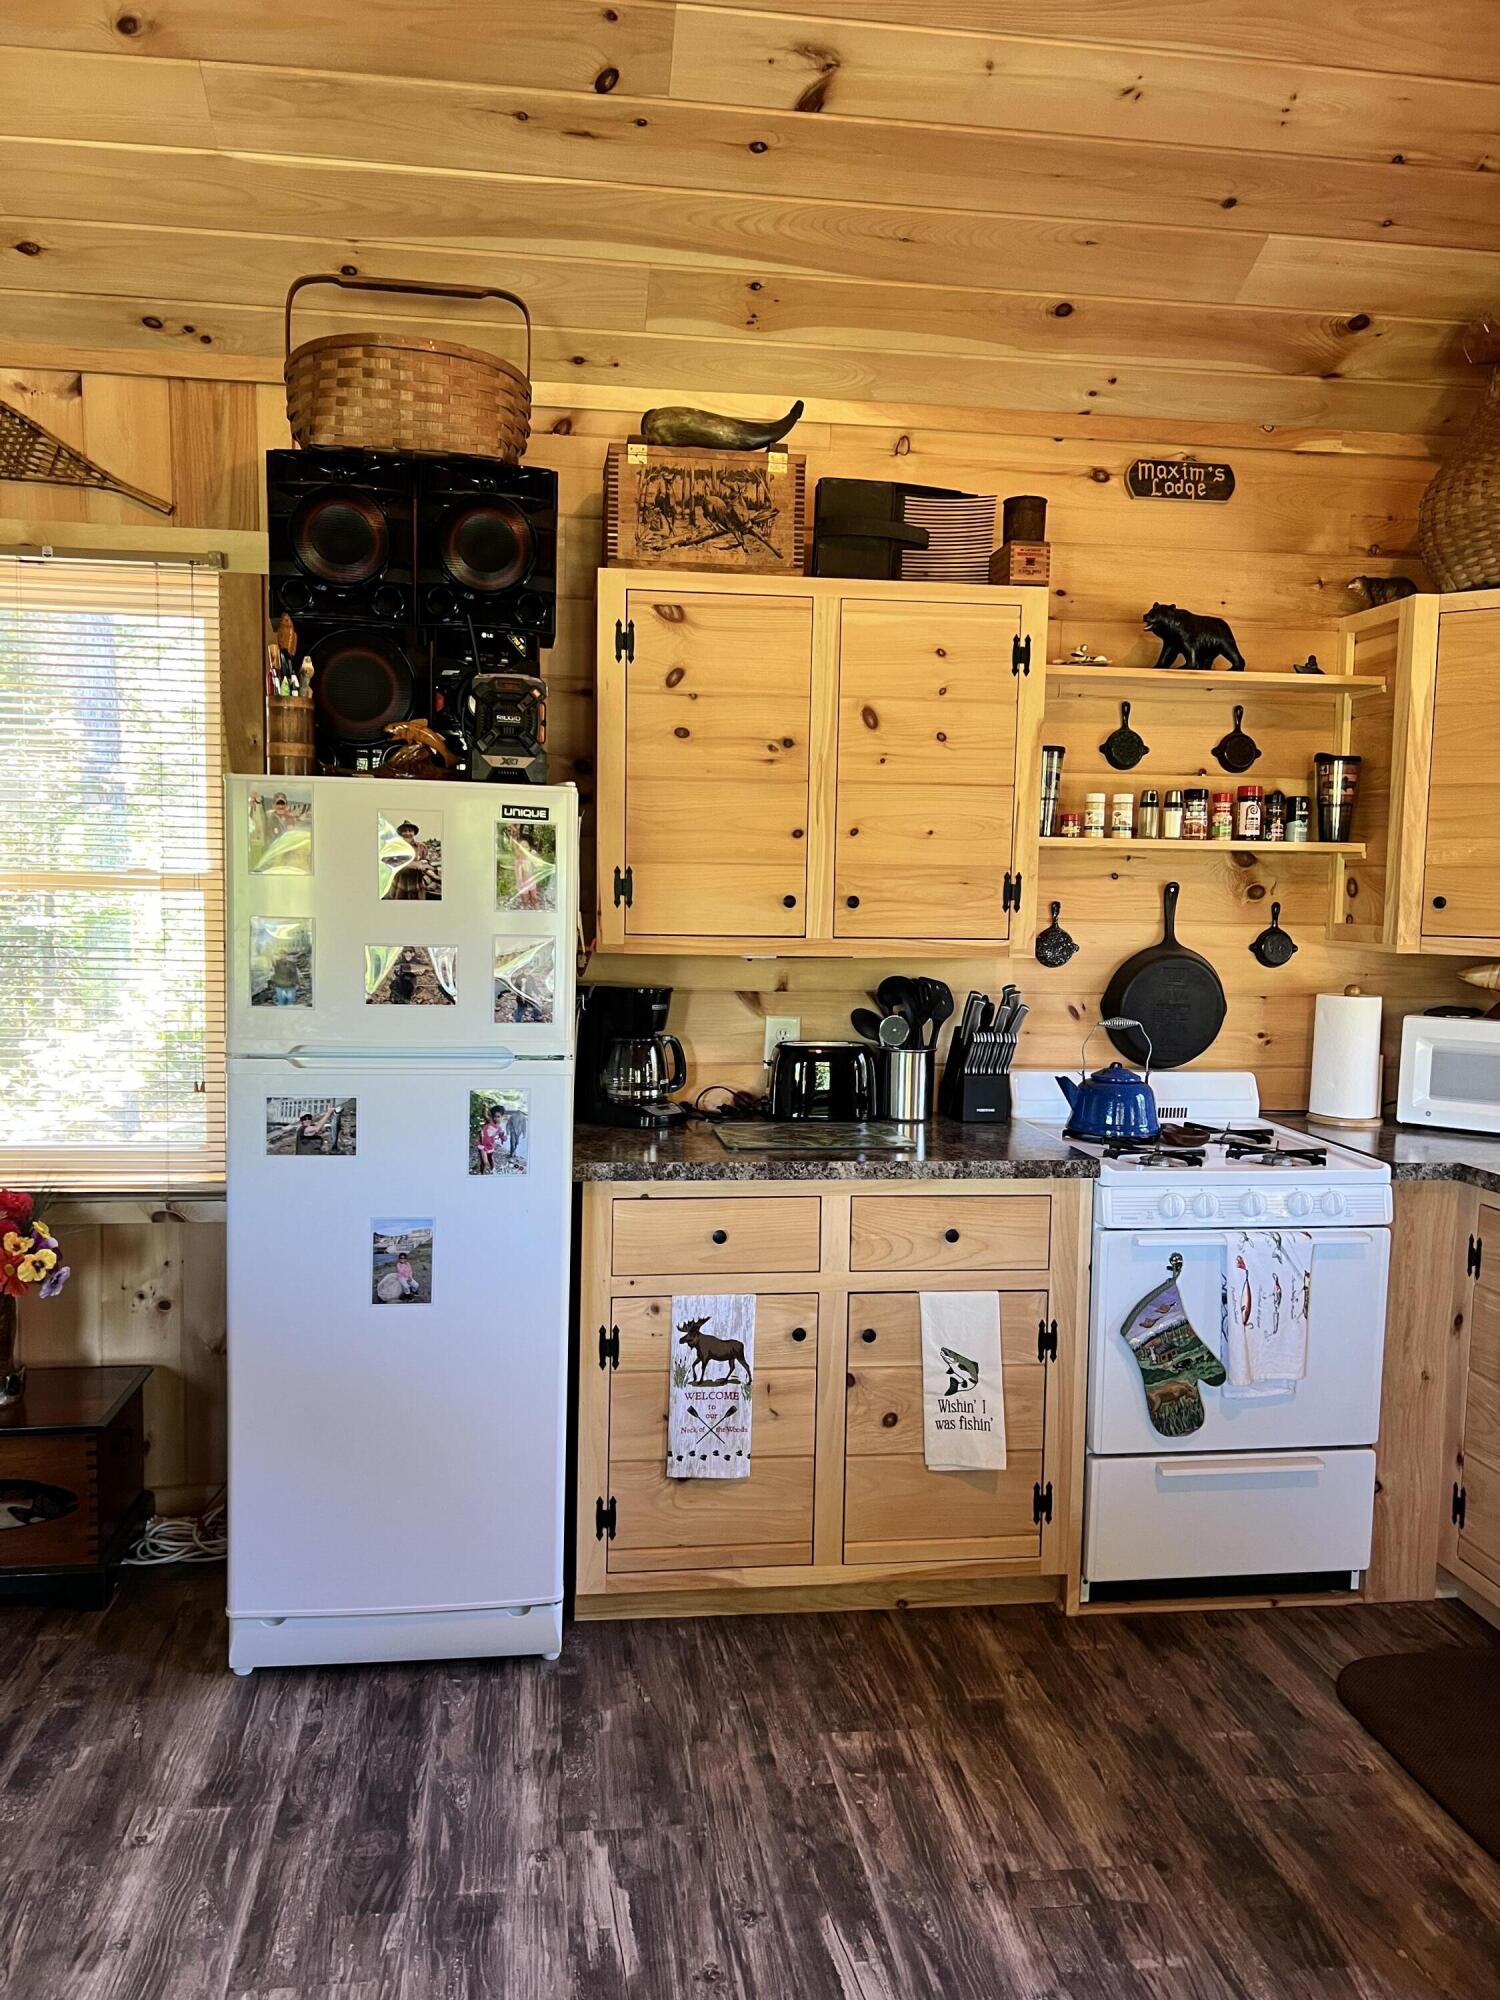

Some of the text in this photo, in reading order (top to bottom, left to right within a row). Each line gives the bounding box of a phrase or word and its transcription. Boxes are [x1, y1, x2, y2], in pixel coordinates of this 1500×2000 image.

[1138, 461, 1226, 483] Maxim's
[1151, 478, 1207, 500] Lodge
[503, 807, 547, 819] UNIQUE
[684, 1391, 740, 1401] WELCOME
[938, 1399, 987, 1414] Wishin' I
[935, 1415, 993, 1431] was fishin'
